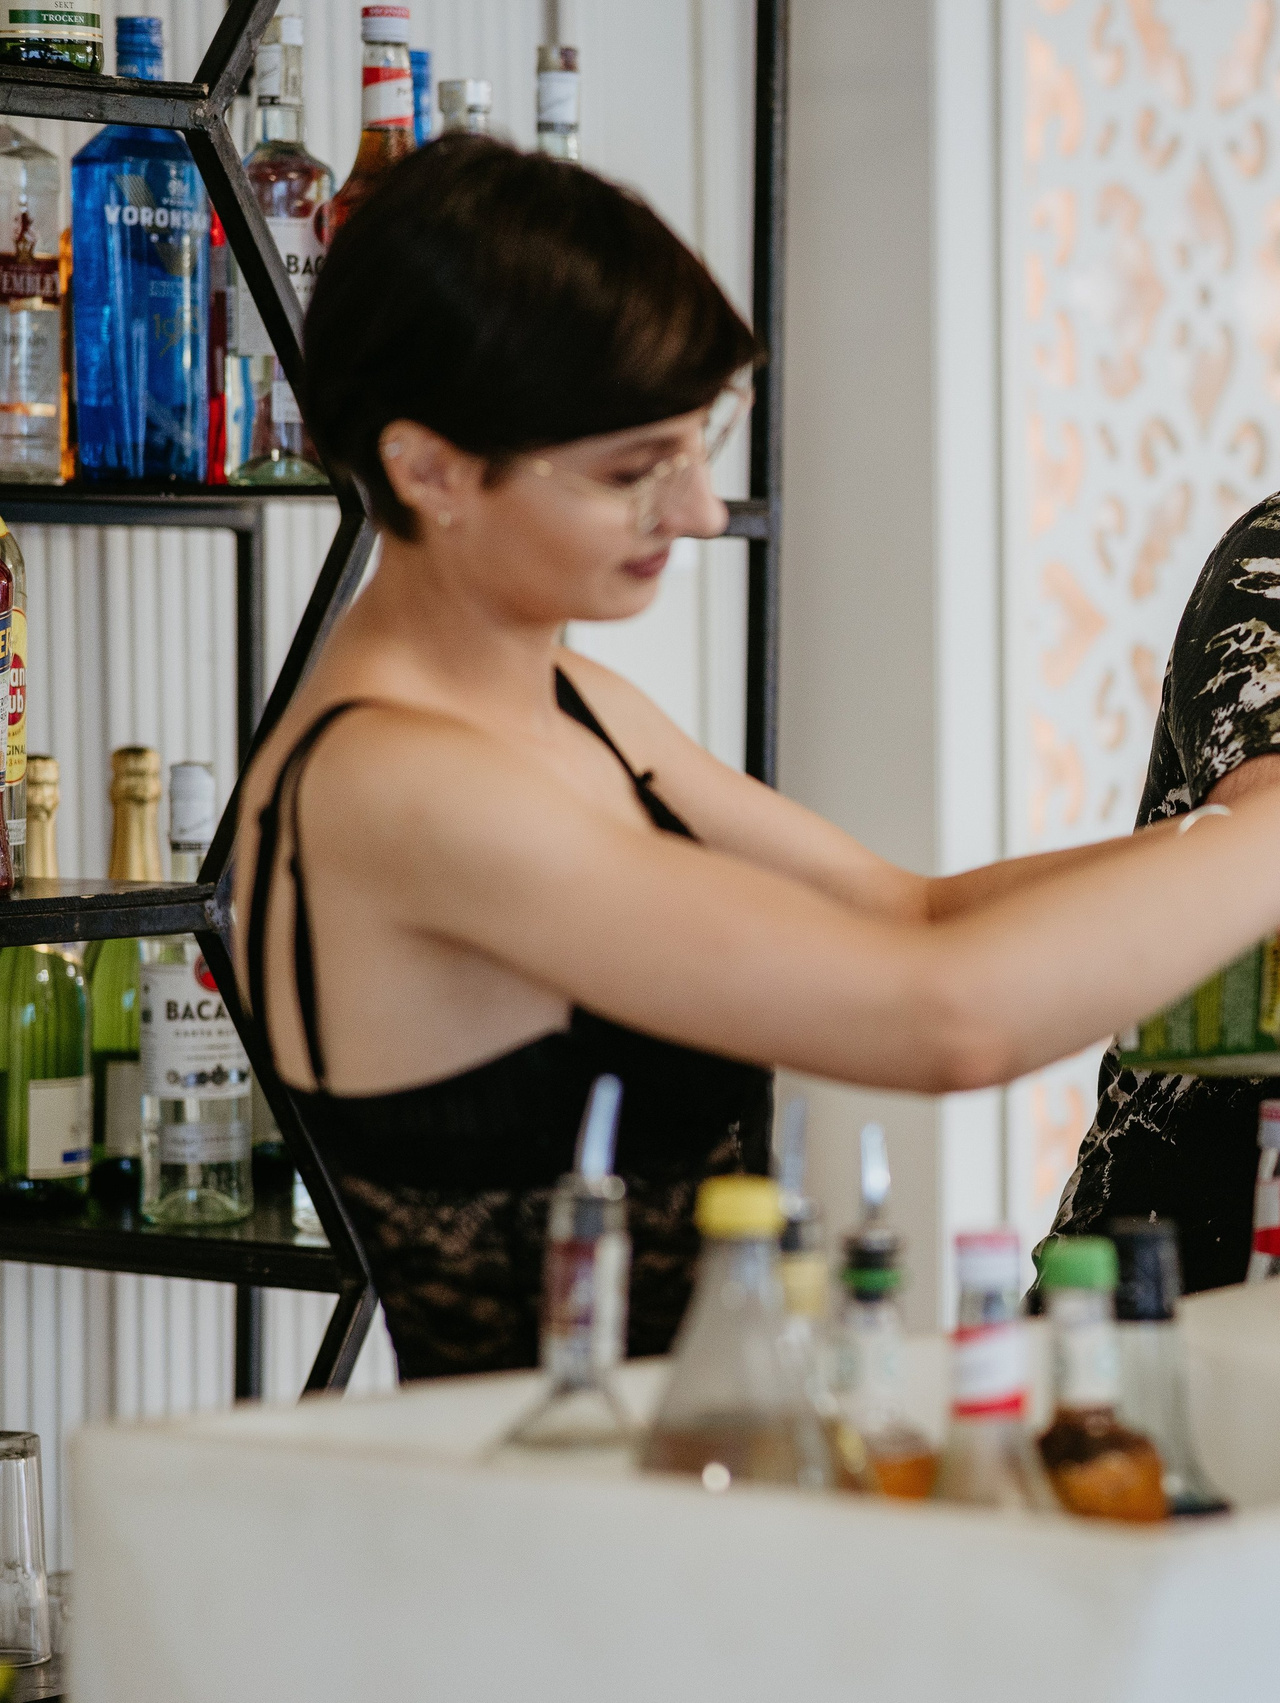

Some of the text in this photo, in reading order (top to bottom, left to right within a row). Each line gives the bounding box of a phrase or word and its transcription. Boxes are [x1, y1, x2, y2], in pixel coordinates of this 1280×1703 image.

[54, 1, 75, 9] SEKT
[41, 13, 85, 24] TROCKEN
[166, 1000, 228, 1020] BACA
